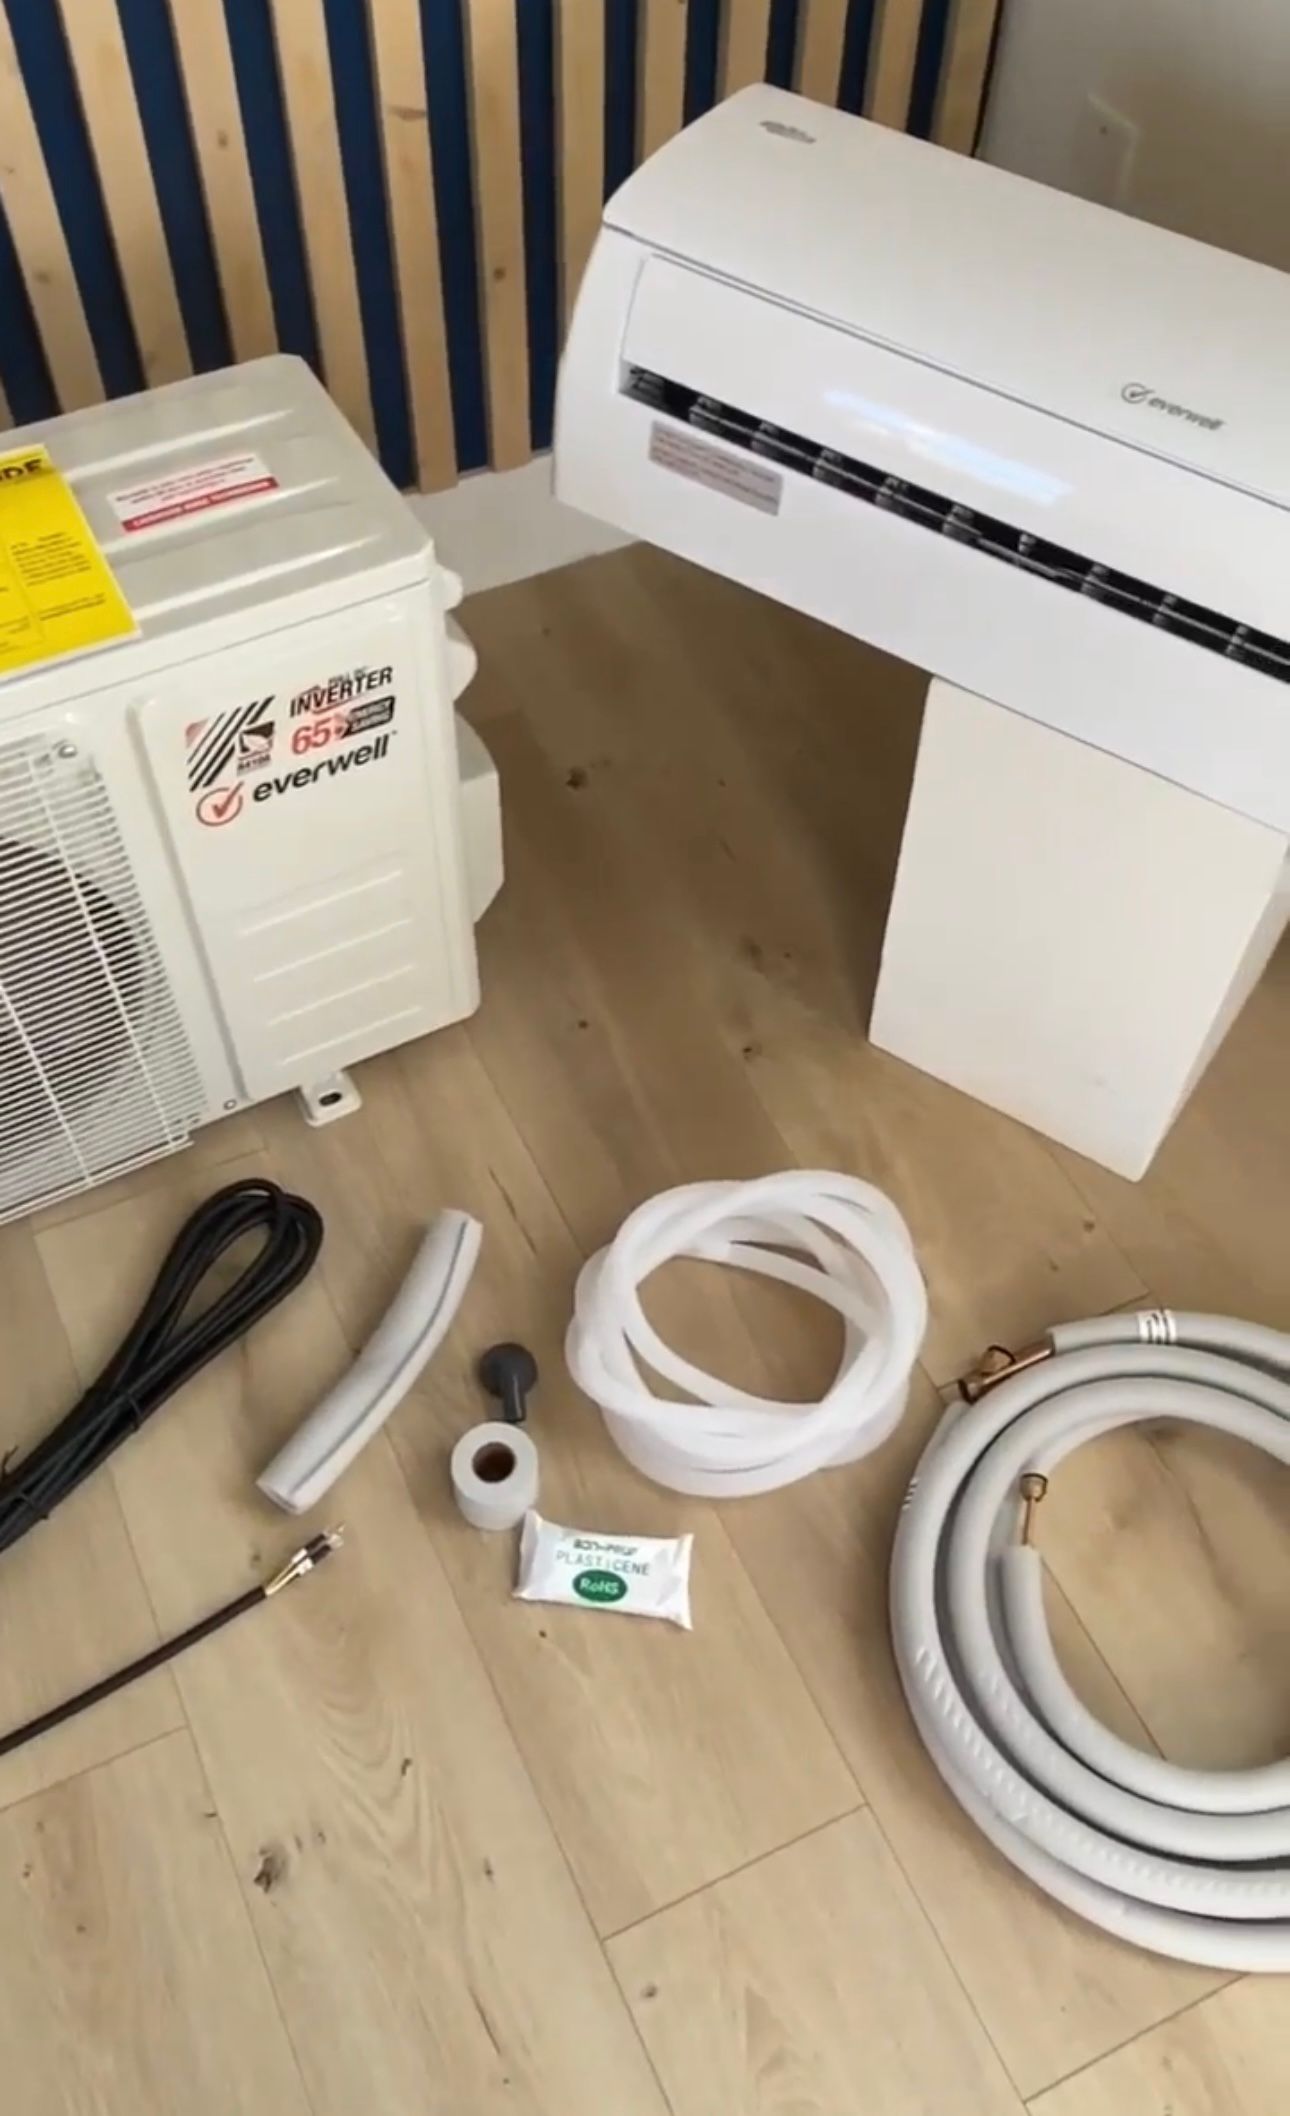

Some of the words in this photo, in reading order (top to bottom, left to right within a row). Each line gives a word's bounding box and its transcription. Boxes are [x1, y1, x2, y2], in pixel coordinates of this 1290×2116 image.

[0, 458, 42, 481] DE
[289, 666, 393, 718] INVERTER
[252, 733, 390, 802] everwell
[556, 1550, 650, 1576] PLASTICENE
[578, 1577, 620, 1596] RoHS
